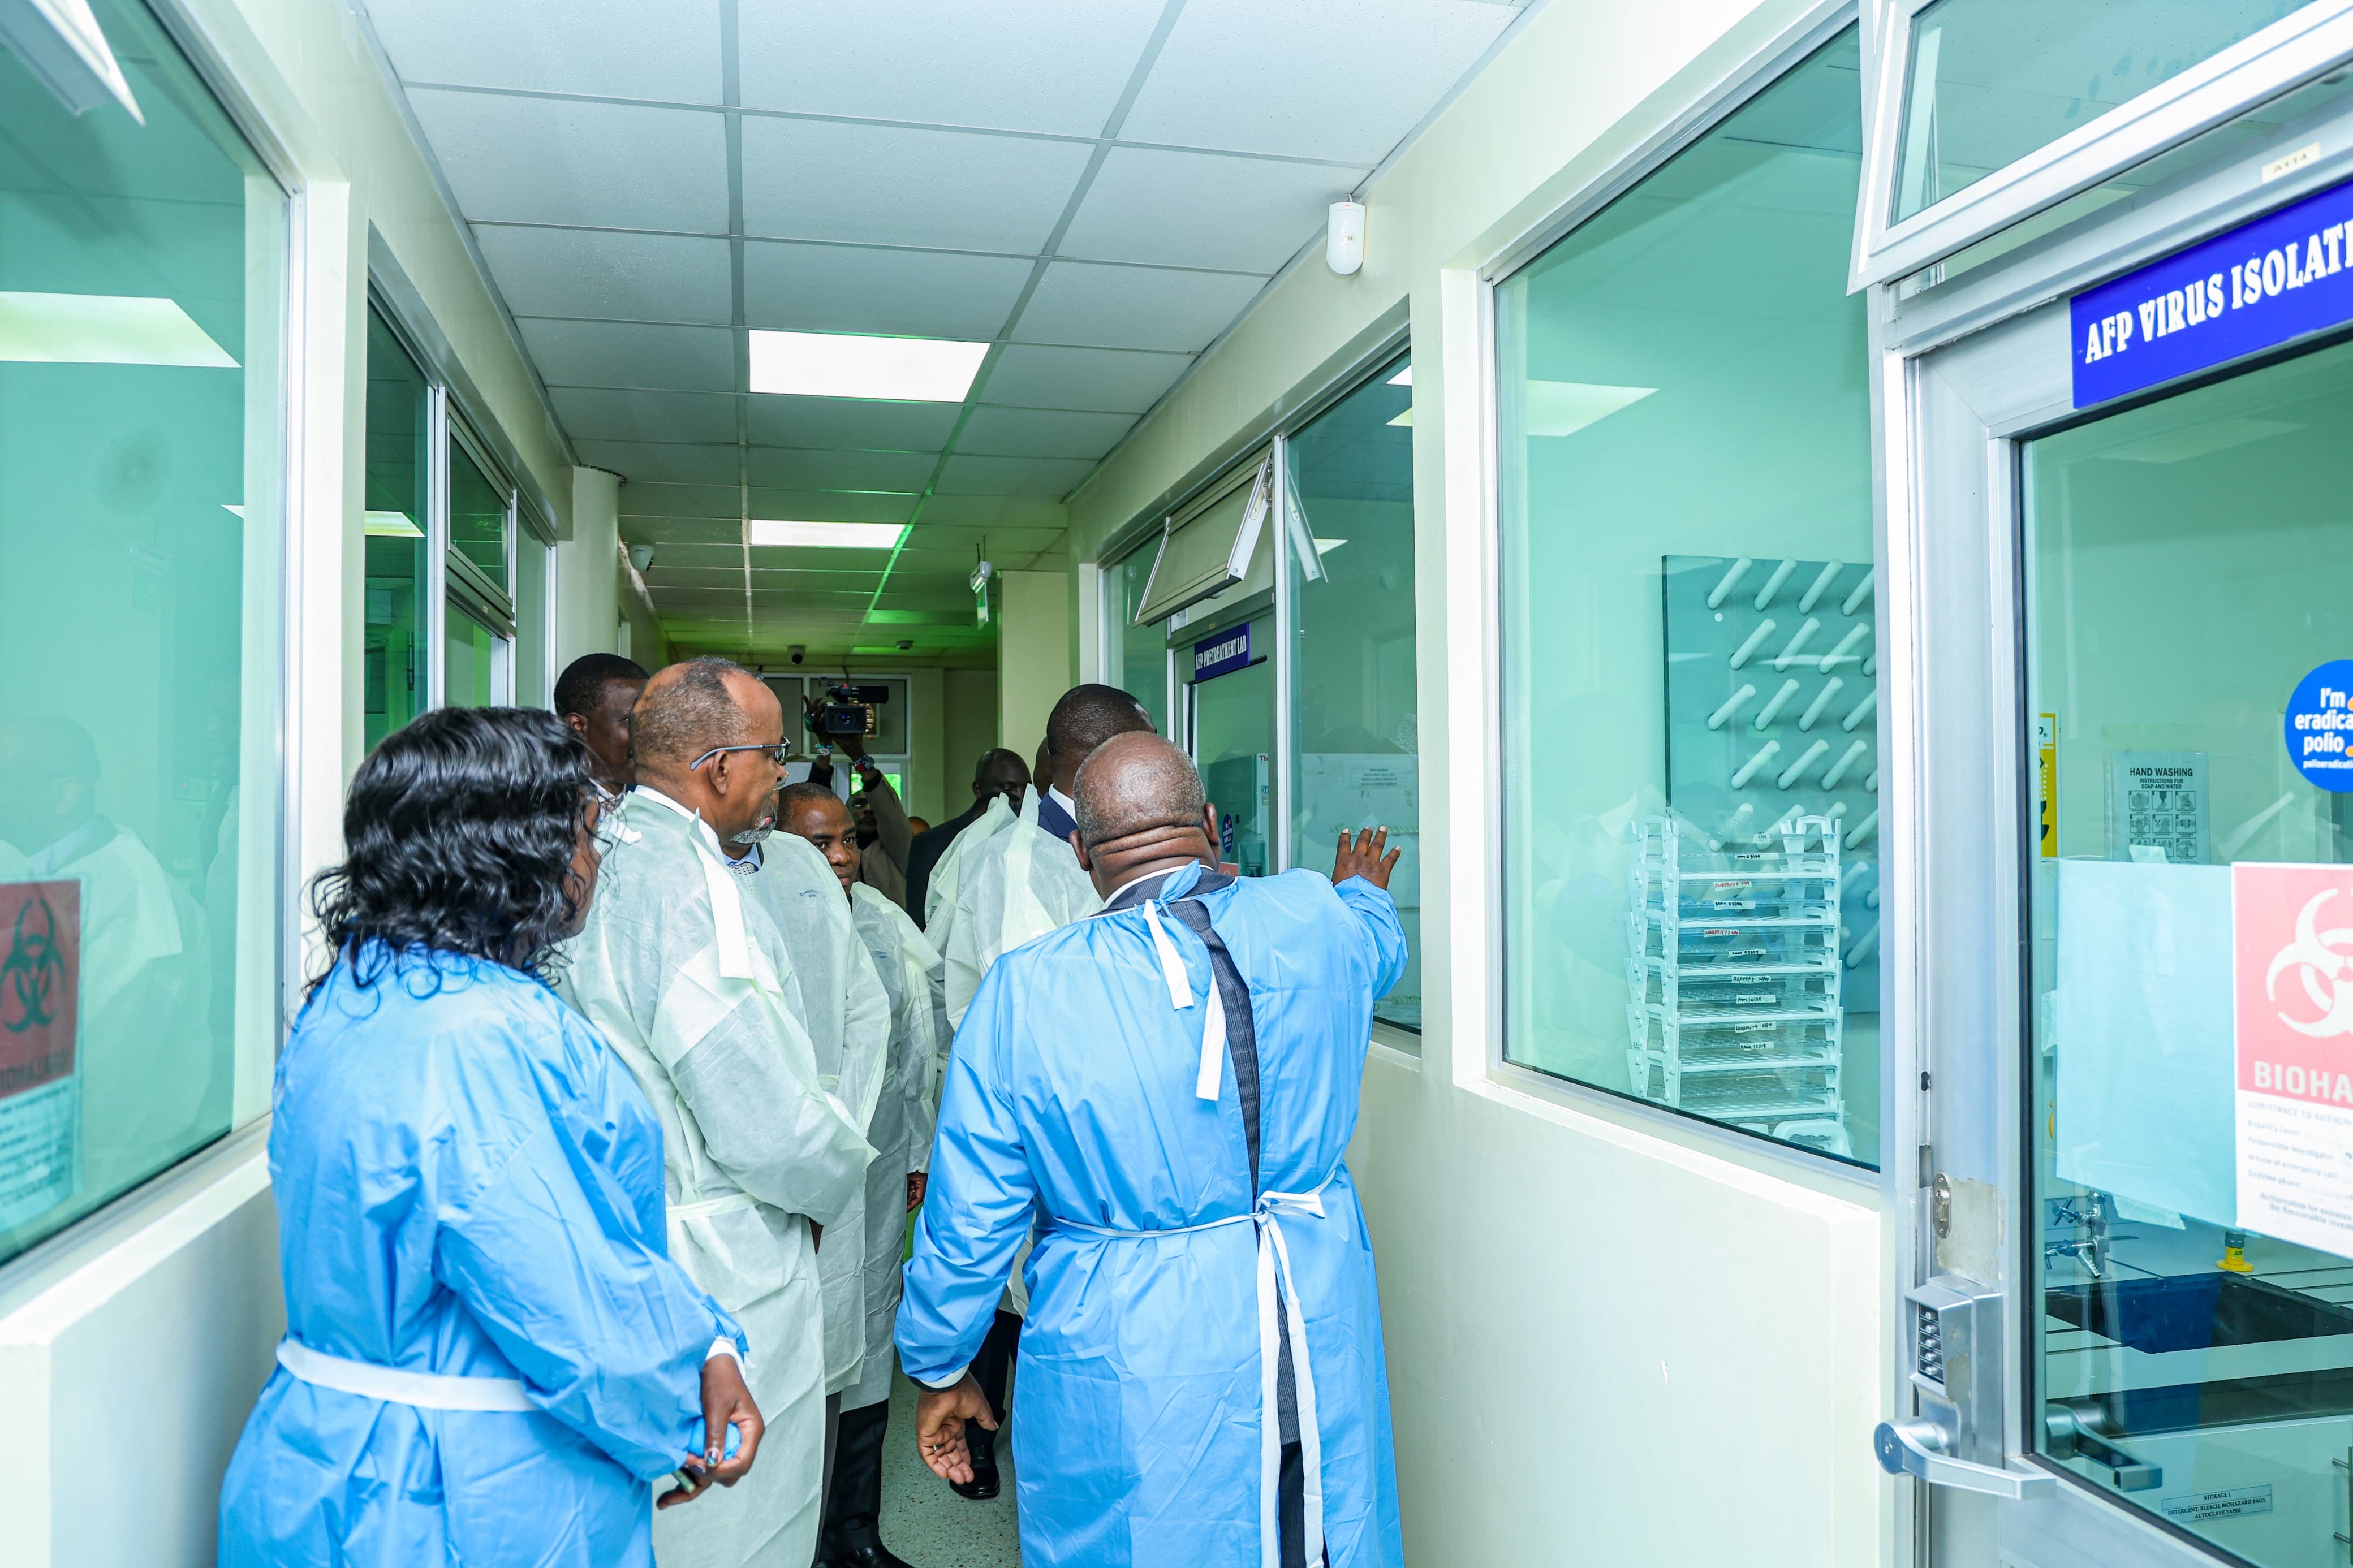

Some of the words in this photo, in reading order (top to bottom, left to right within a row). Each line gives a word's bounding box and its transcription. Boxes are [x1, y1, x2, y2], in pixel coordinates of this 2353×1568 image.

[2085, 311, 2133, 364] AFP
[2138, 273, 2224, 342] VIRUS
[1204, 638, 1236, 667] PRETREATMENT
[1237, 634, 1247, 654] LAB
[2320, 687, 2346, 708] I'm
[2303, 731, 2345, 756] polio
[2154, 768, 2193, 776] WASHING
[2253, 1060, 2353, 1104] BIOHA
[2301, 1109, 2312, 1119] TO
[2168, 1507, 2200, 1515] DETERGENT,
[2222, 1499, 2252, 1508] BIOHAZARD
[2195, 1510, 2225, 1519] AUTOCLAVE
